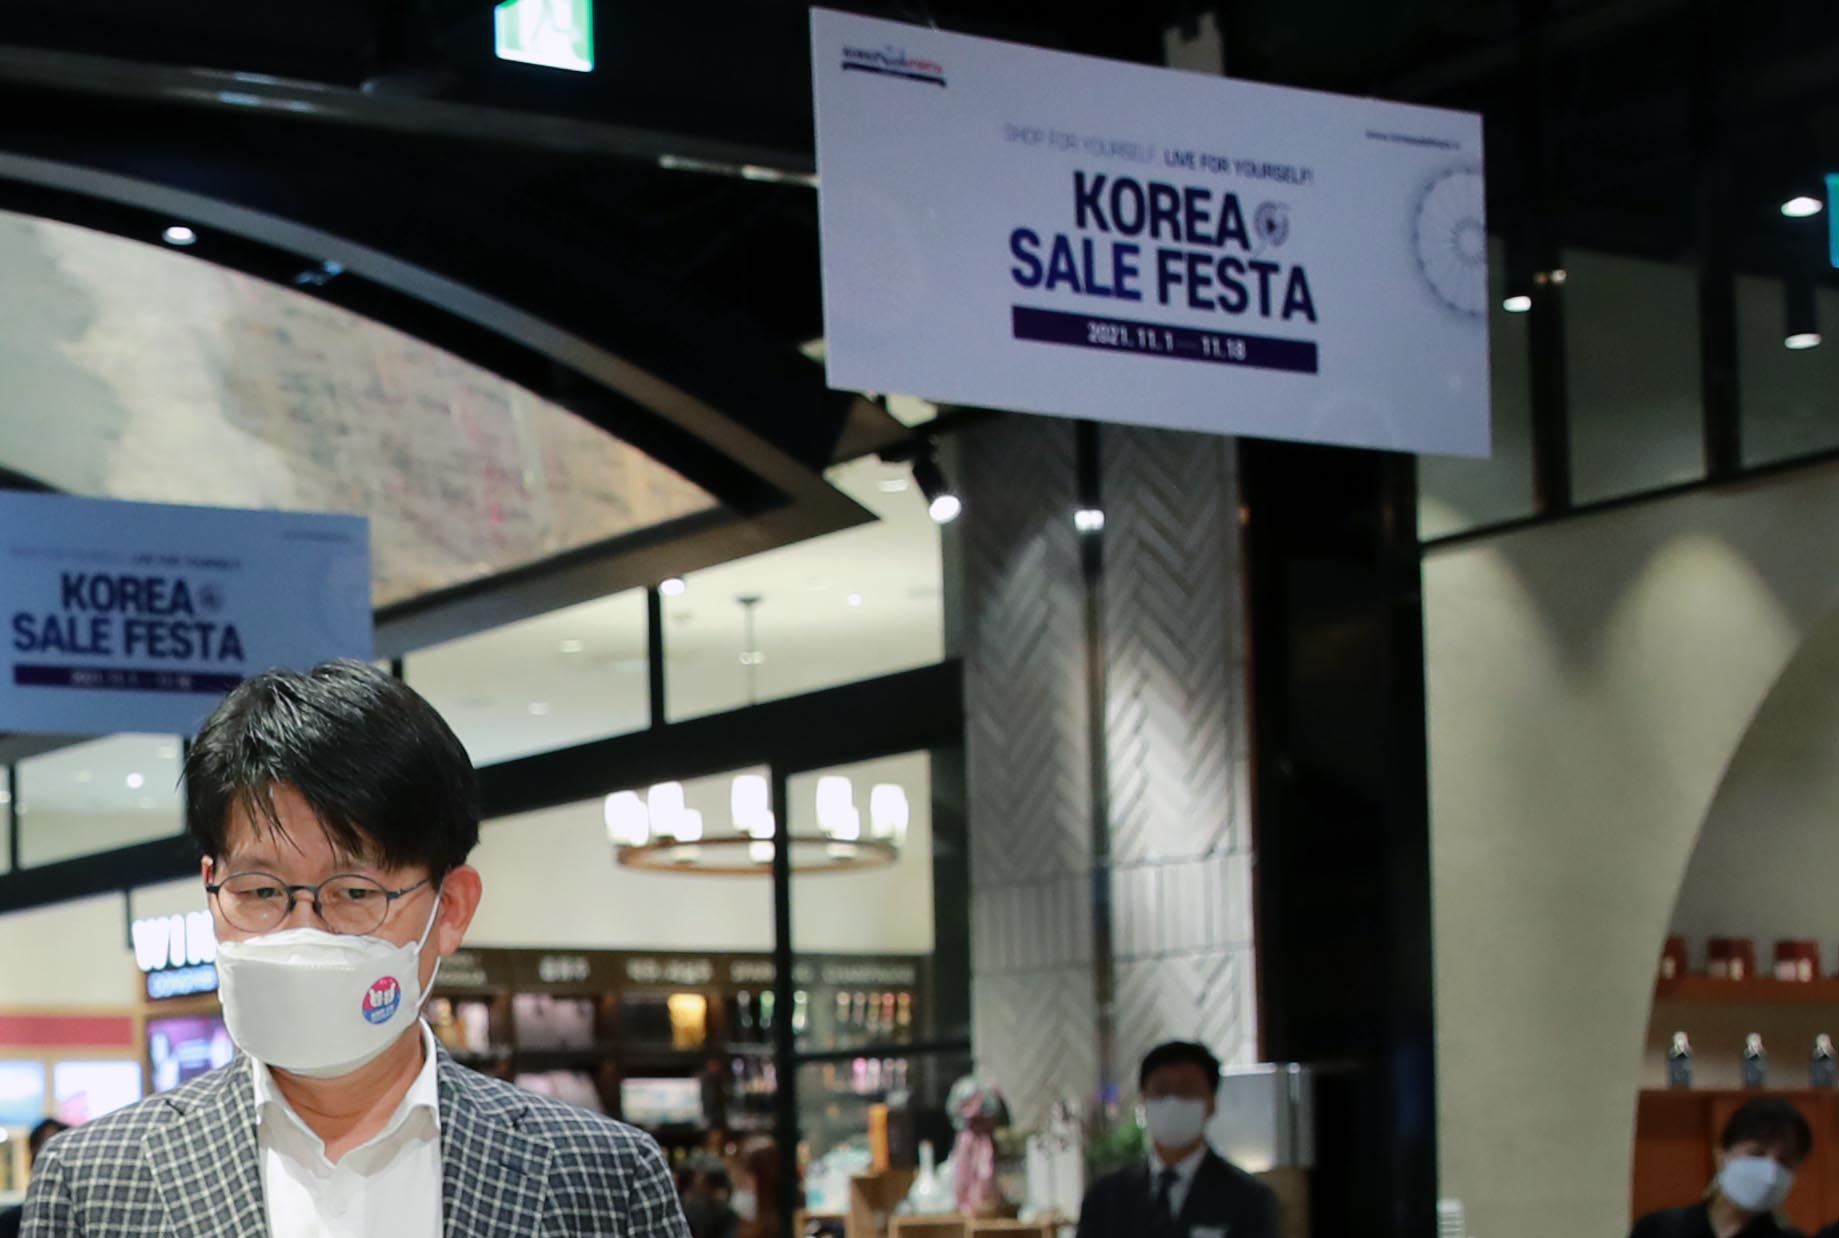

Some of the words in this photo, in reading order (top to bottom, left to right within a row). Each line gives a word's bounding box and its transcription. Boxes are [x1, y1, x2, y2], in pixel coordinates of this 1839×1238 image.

[1163, 148, 1197, 170] LIVE
[1199, 154, 1230, 174] FOR
[1073, 169, 1252, 251] KOREA
[1009, 226, 1143, 301] SALE
[1156, 246, 1318, 323] FESTA
[61, 571, 195, 616] KOREA
[12, 611, 114, 655] SALE
[123, 619, 246, 663] FESTA
